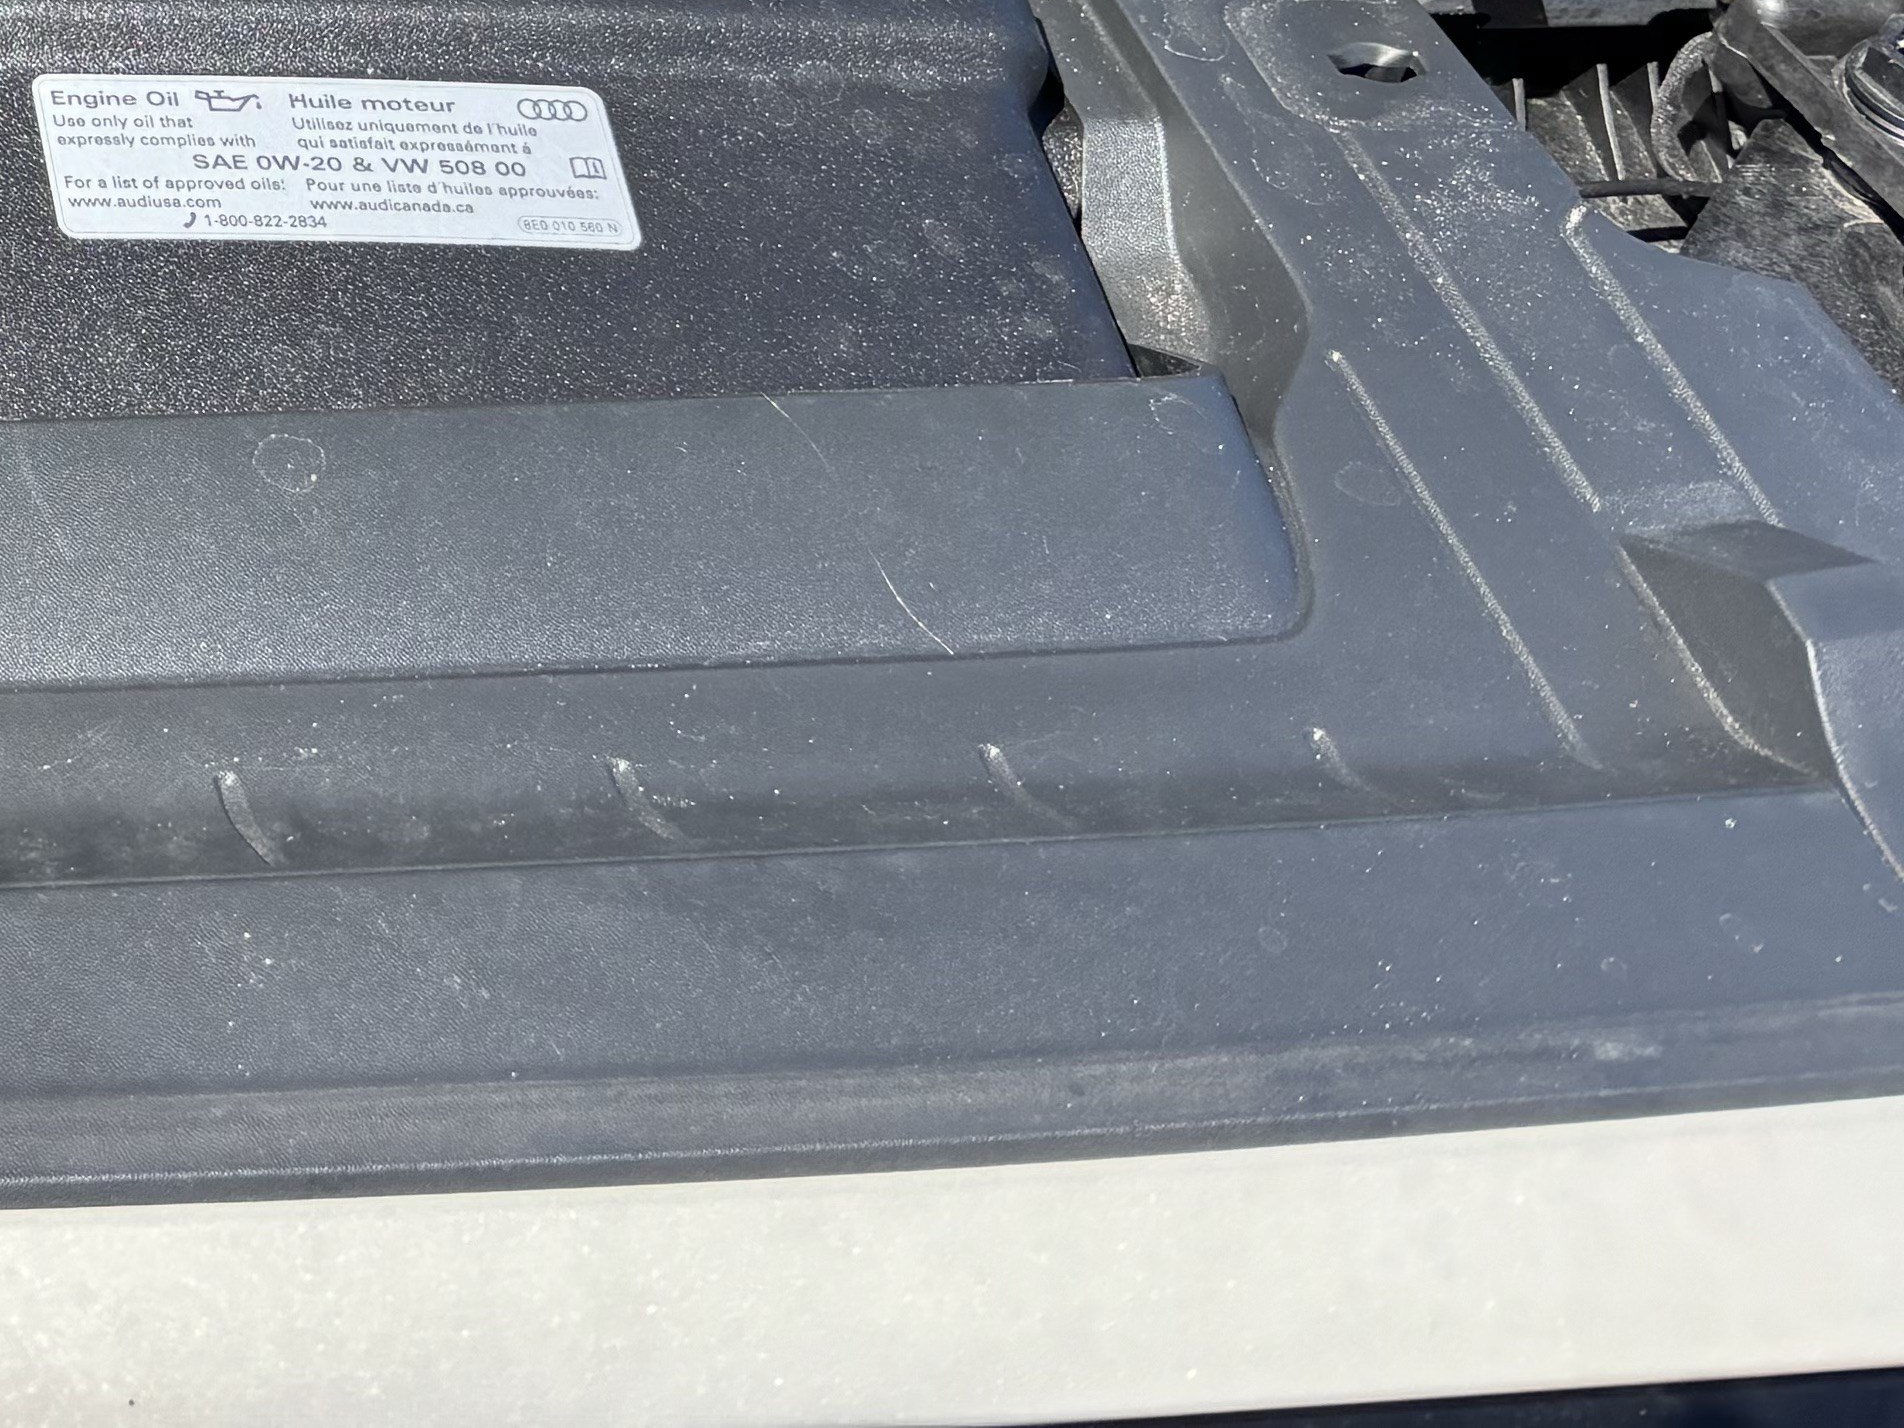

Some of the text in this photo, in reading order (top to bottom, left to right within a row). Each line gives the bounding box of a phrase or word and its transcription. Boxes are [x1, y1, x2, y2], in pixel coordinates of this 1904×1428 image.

[50, 90, 179, 109] Engine Oil
[288, 93, 456, 113] Huile moteur
[52, 114, 194, 130] Use only oil that
[291, 117, 538, 137] Utilisez uniquement de l'huile
[57, 132, 256, 149] expressly complies with
[297, 138, 325, 151] qui
[329, 137, 396, 151] satisfait
[192, 154, 526, 177] SAE 0W-20 & VW 508 00
[63, 175, 92, 189] For
[97, 178, 108, 189] a
[111, 176, 139, 189] list
[142, 176, 159, 189] of
[165, 177, 246, 192] approved
[305, 178, 345, 192] Pour
[350, 182, 382, 193] une
[386, 180, 422, 194] liste
[67, 195, 222, 209] www.audiusa.com
[309, 198, 475, 214] www.audicanada.ca
[204, 215, 328, 229] 1-800-822-2834
[523, 219, 549, 231] 8E0
[552, 220, 576, 232] 010
[607, 222, 618, 233] N
